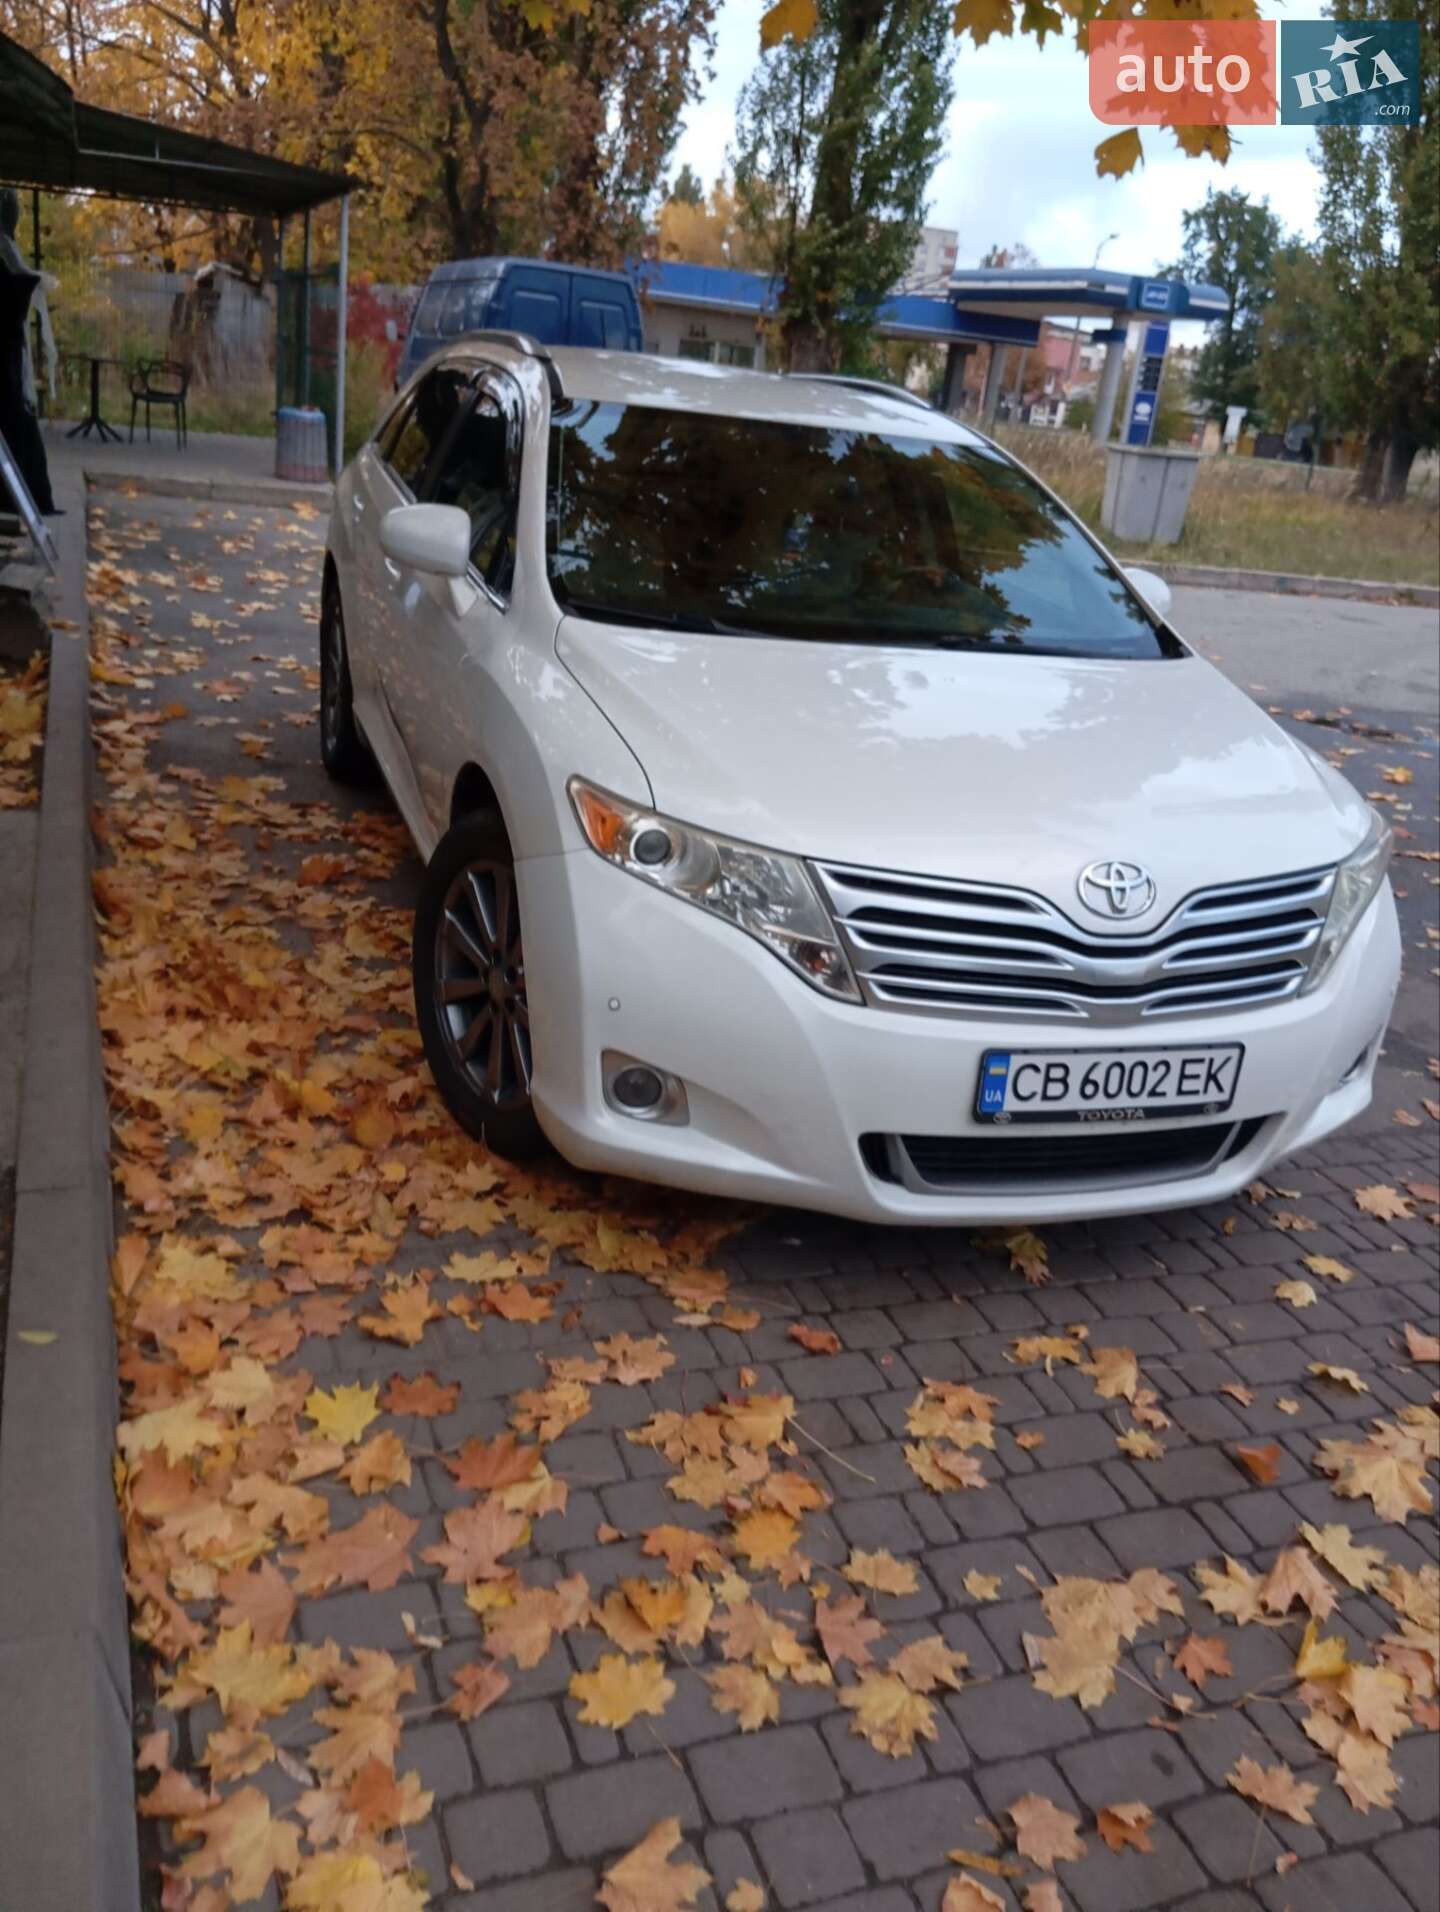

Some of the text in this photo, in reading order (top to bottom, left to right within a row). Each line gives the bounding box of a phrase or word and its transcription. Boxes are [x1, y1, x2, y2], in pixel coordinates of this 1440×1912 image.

[1011, 1056, 1233, 1102] CB 6002 EK
[984, 1090, 1003, 1103] UA
[1077, 1108, 1146, 1122] TOYOTA
